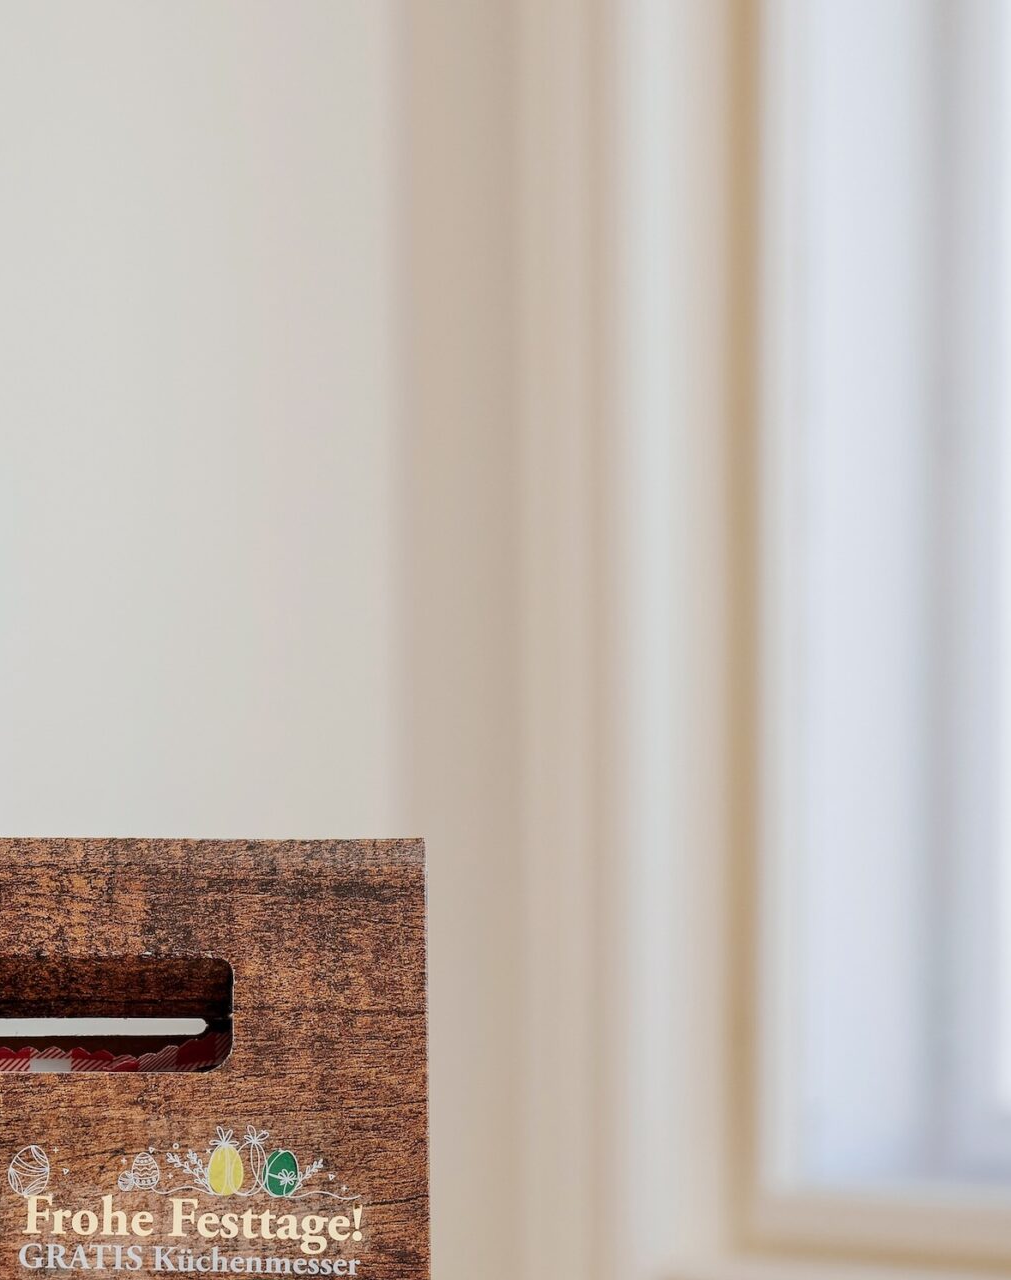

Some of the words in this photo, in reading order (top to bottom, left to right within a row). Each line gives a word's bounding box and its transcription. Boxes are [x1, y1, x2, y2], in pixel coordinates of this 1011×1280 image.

[22, 1194, 154, 1237] Frohe
[168, 1197, 364, 1255] Festtage!
[18, 1242, 143, 1271] GRATIS
[152, 1245, 361, 1276] Küchenmesser
